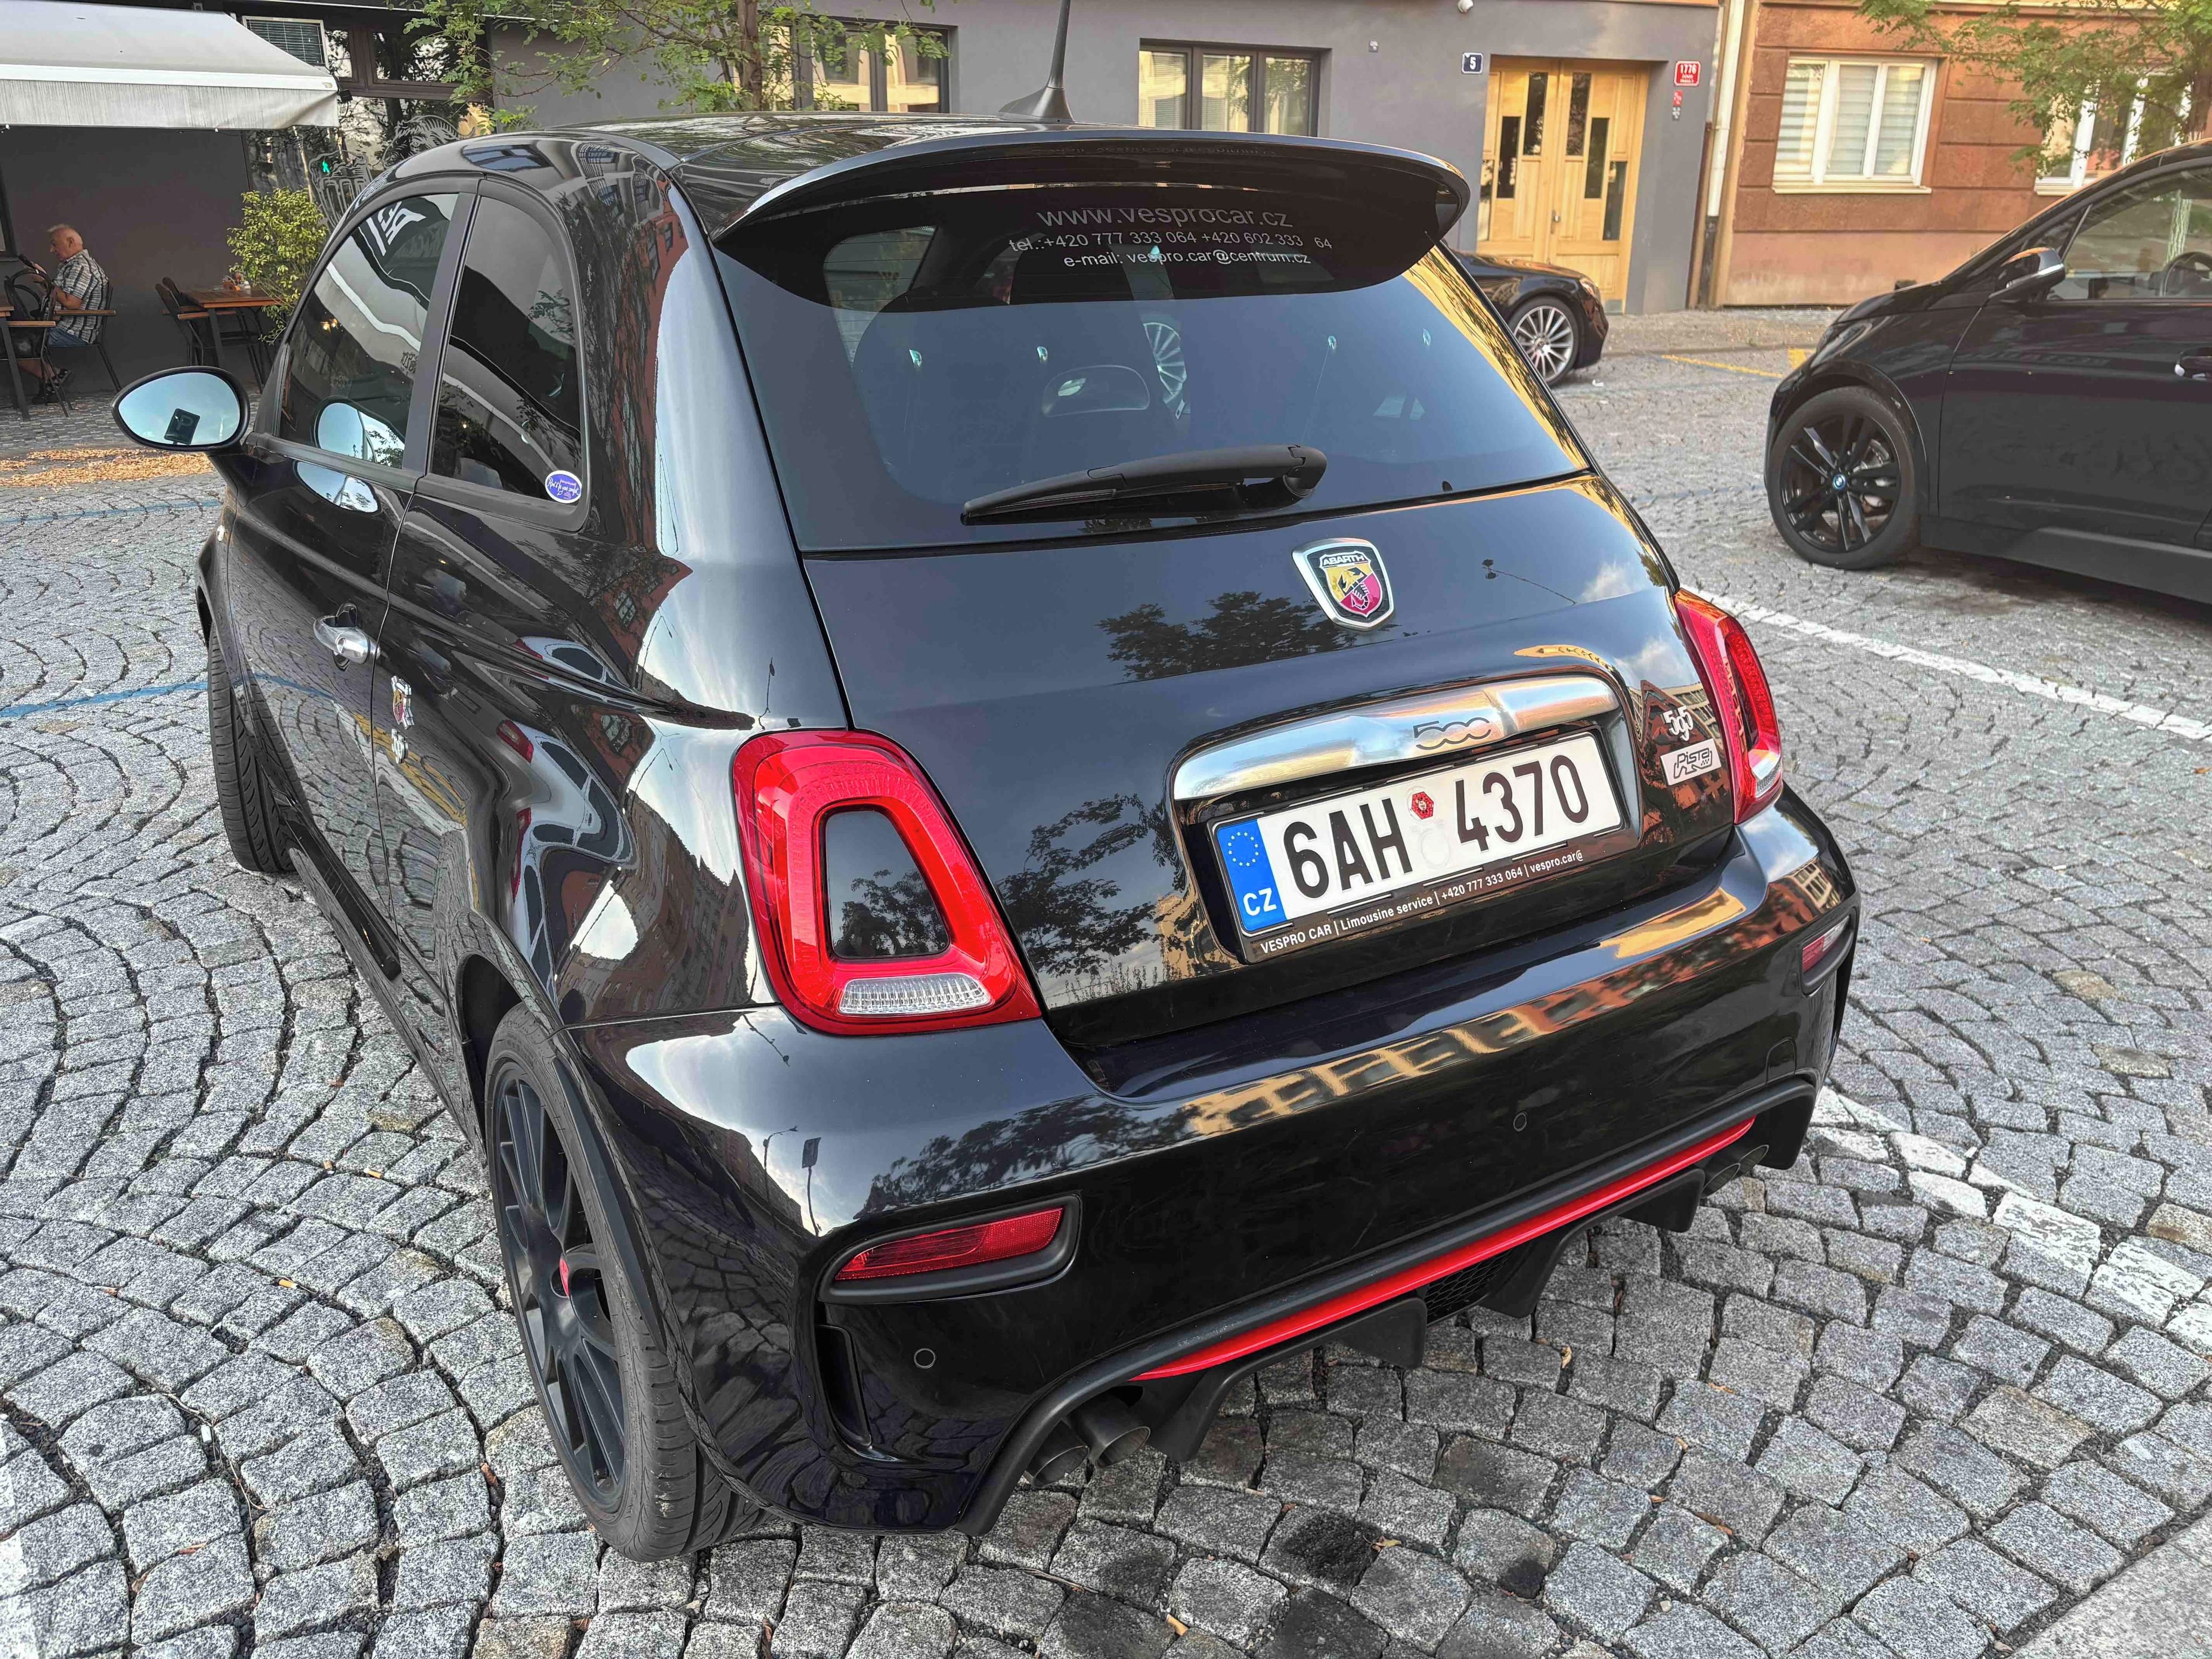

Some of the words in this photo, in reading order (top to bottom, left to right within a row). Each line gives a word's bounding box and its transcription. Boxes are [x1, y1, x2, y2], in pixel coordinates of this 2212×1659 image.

[1469, 56, 1476, 70] 5
[1036, 208, 1293, 227] www.vesprocar.cz
[1091, 232, 1123, 245] 777
[1130, 232, 1162, 244] 333
[1165, 232, 1197, 243] 064
[1202, 232, 1240, 244] +420
[1244, 232, 1273, 245] 602
[1275, 234, 1303, 246] 333
[1064, 252, 1123, 267] e-mail:
[1126, 249, 1311, 265] vespro.car@centrum.cz
[1323, 555, 1365, 566] ABARTH
[1413, 717, 1492, 750] 500
[1662, 705, 1694, 741] 595
[1283, 798, 1413, 899] 6AH
[1455, 754, 1589, 852] 4370
[1243, 887, 1277, 916] CZ
[1260, 932, 1306, 954] VESPRO
[1309, 924, 1332, 940] CAR
[1341, 909, 1394, 930] Limousine
[1397, 894, 1433, 911] service
[1441, 884, 1466, 900] +420
[1466, 879, 1483, 892] 777
[1485, 873, 1503, 886] 333
[1505, 867, 1523, 881] 064
[1529, 849, 1583, 873] vespro.car@
